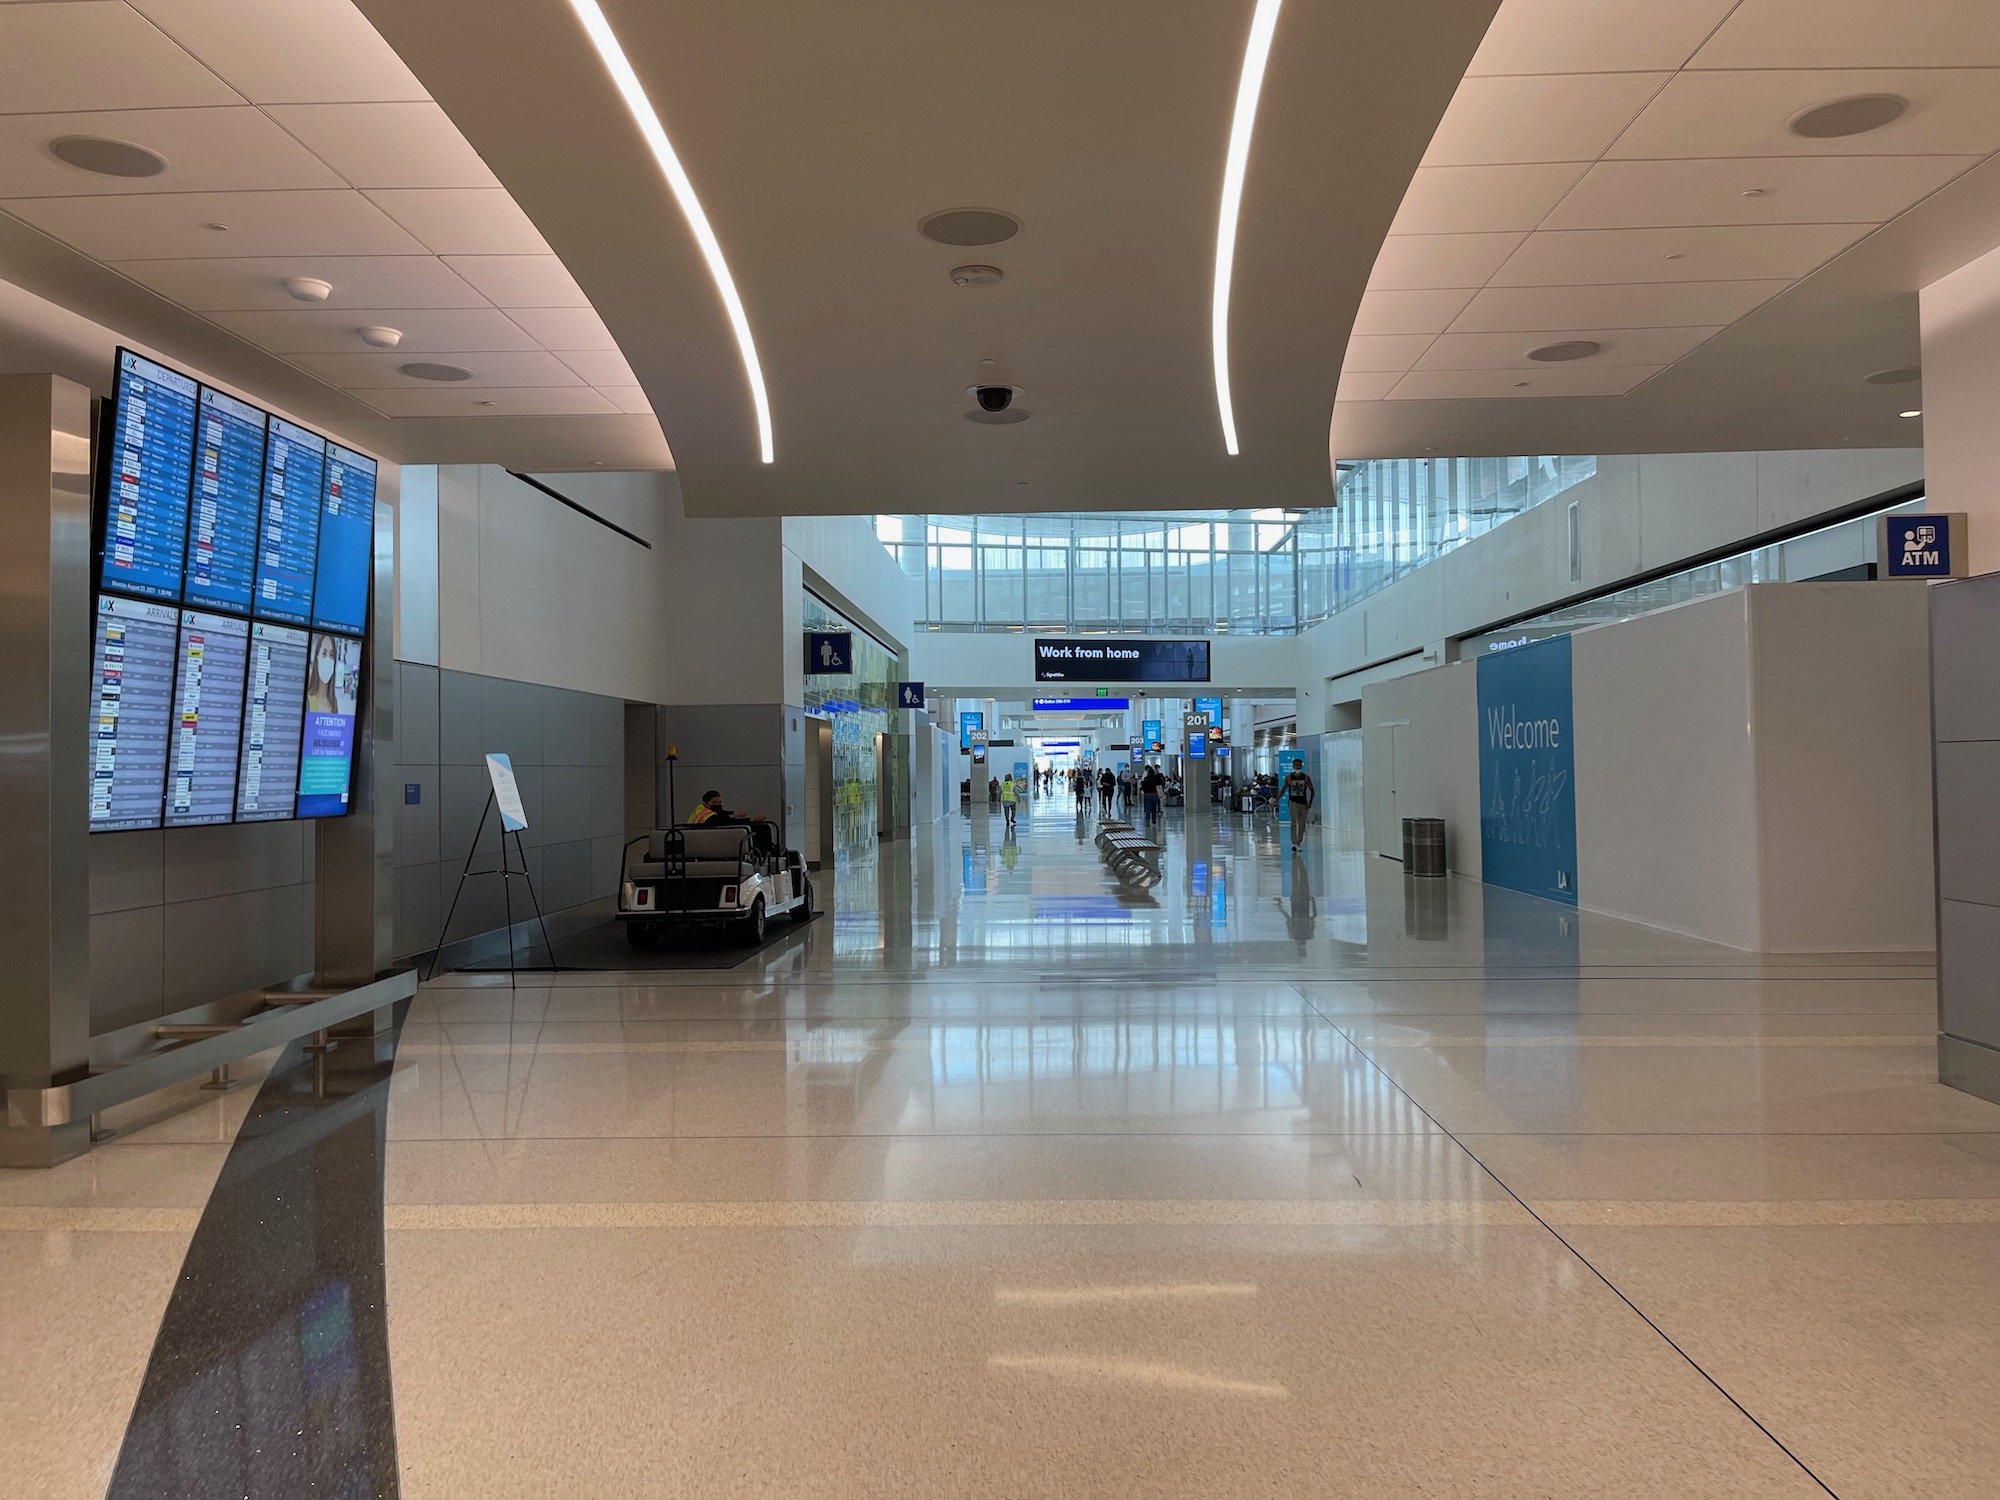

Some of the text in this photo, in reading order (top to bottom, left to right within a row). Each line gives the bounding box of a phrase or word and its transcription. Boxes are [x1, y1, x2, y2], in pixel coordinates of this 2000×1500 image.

[124, 354, 136, 370] LAX
[157, 370, 196, 394] DEPARTURES
[202, 389, 214, 404] LAX
[231, 402, 265, 424] DEPARTURES
[270, 419, 281, 432] LAX
[327, 444, 337, 456] LAX
[1902, 550, 1939, 566] ATM
[100, 598, 115, 612] LAX
[146, 607, 178, 620] ARRIVALS
[183, 614, 196, 625] LAX
[222, 620, 248, 632] ARRIVALS
[254, 624, 264, 637] LAX
[1039, 646, 1140, 659] Work from home
[315, 716, 346, 727] ATTENTION
[1187, 715, 1207, 725] 201
[1488, 704, 1560, 750] Welcome
[1558, 870, 1572, 890] LAX
